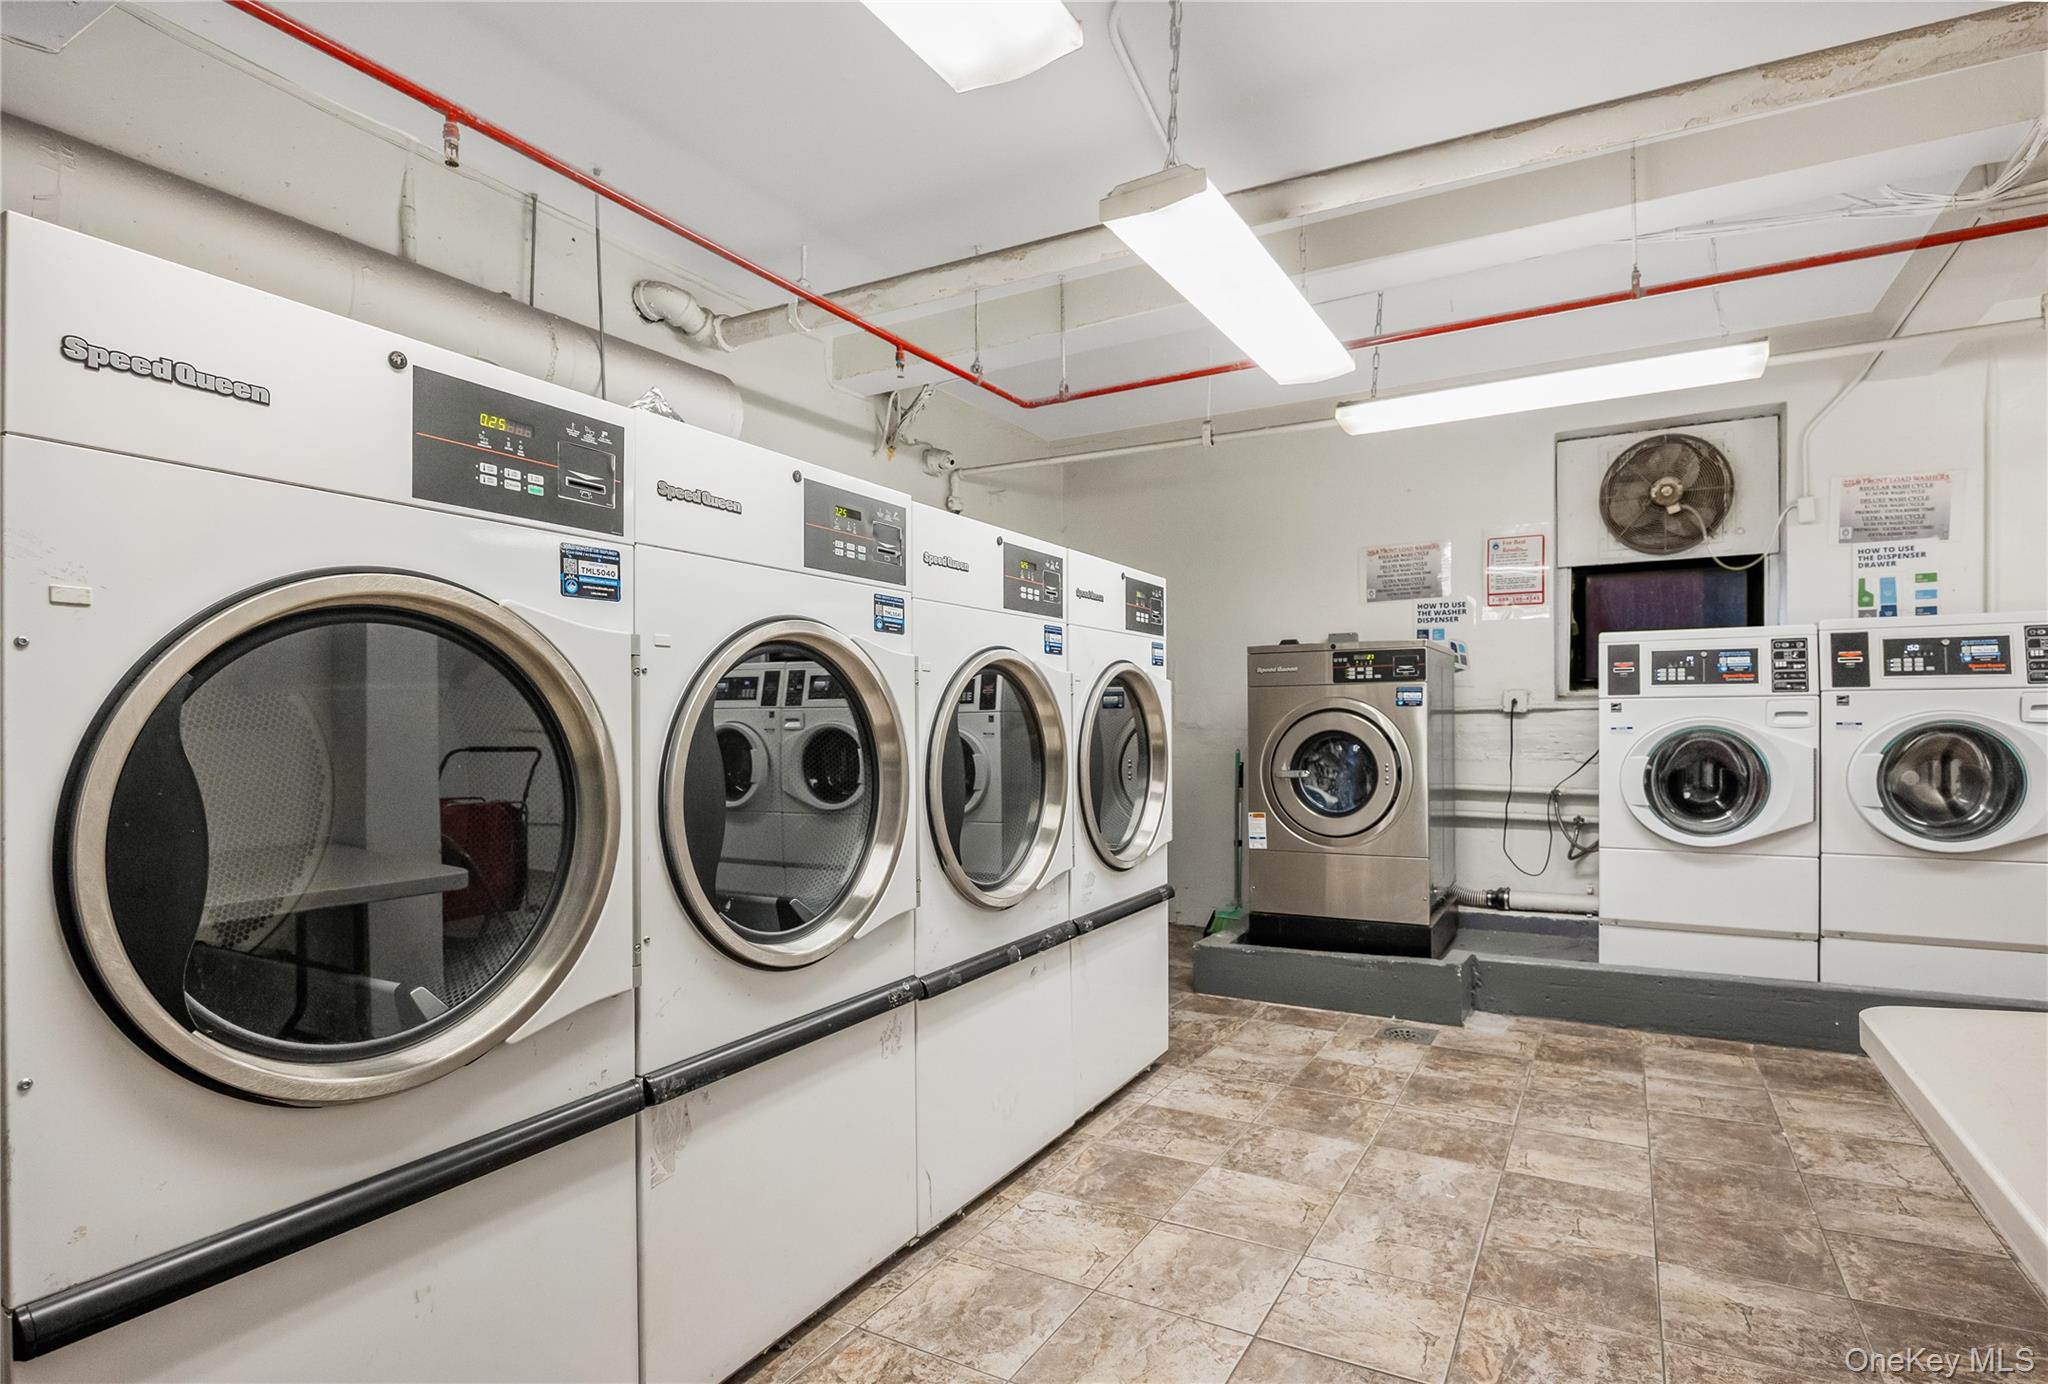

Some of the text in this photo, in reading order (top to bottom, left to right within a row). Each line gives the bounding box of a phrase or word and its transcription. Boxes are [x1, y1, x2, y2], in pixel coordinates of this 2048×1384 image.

[61, 335, 270, 406] Speed Queen
[657, 480, 742, 515] Speed Queen
[923, 551, 948, 567] Speed
[1877, 552, 1926, 560] DISPENSER
[581, 566, 616, 577] TML5040
[1417, 616, 1459, 624] DISPENSER
